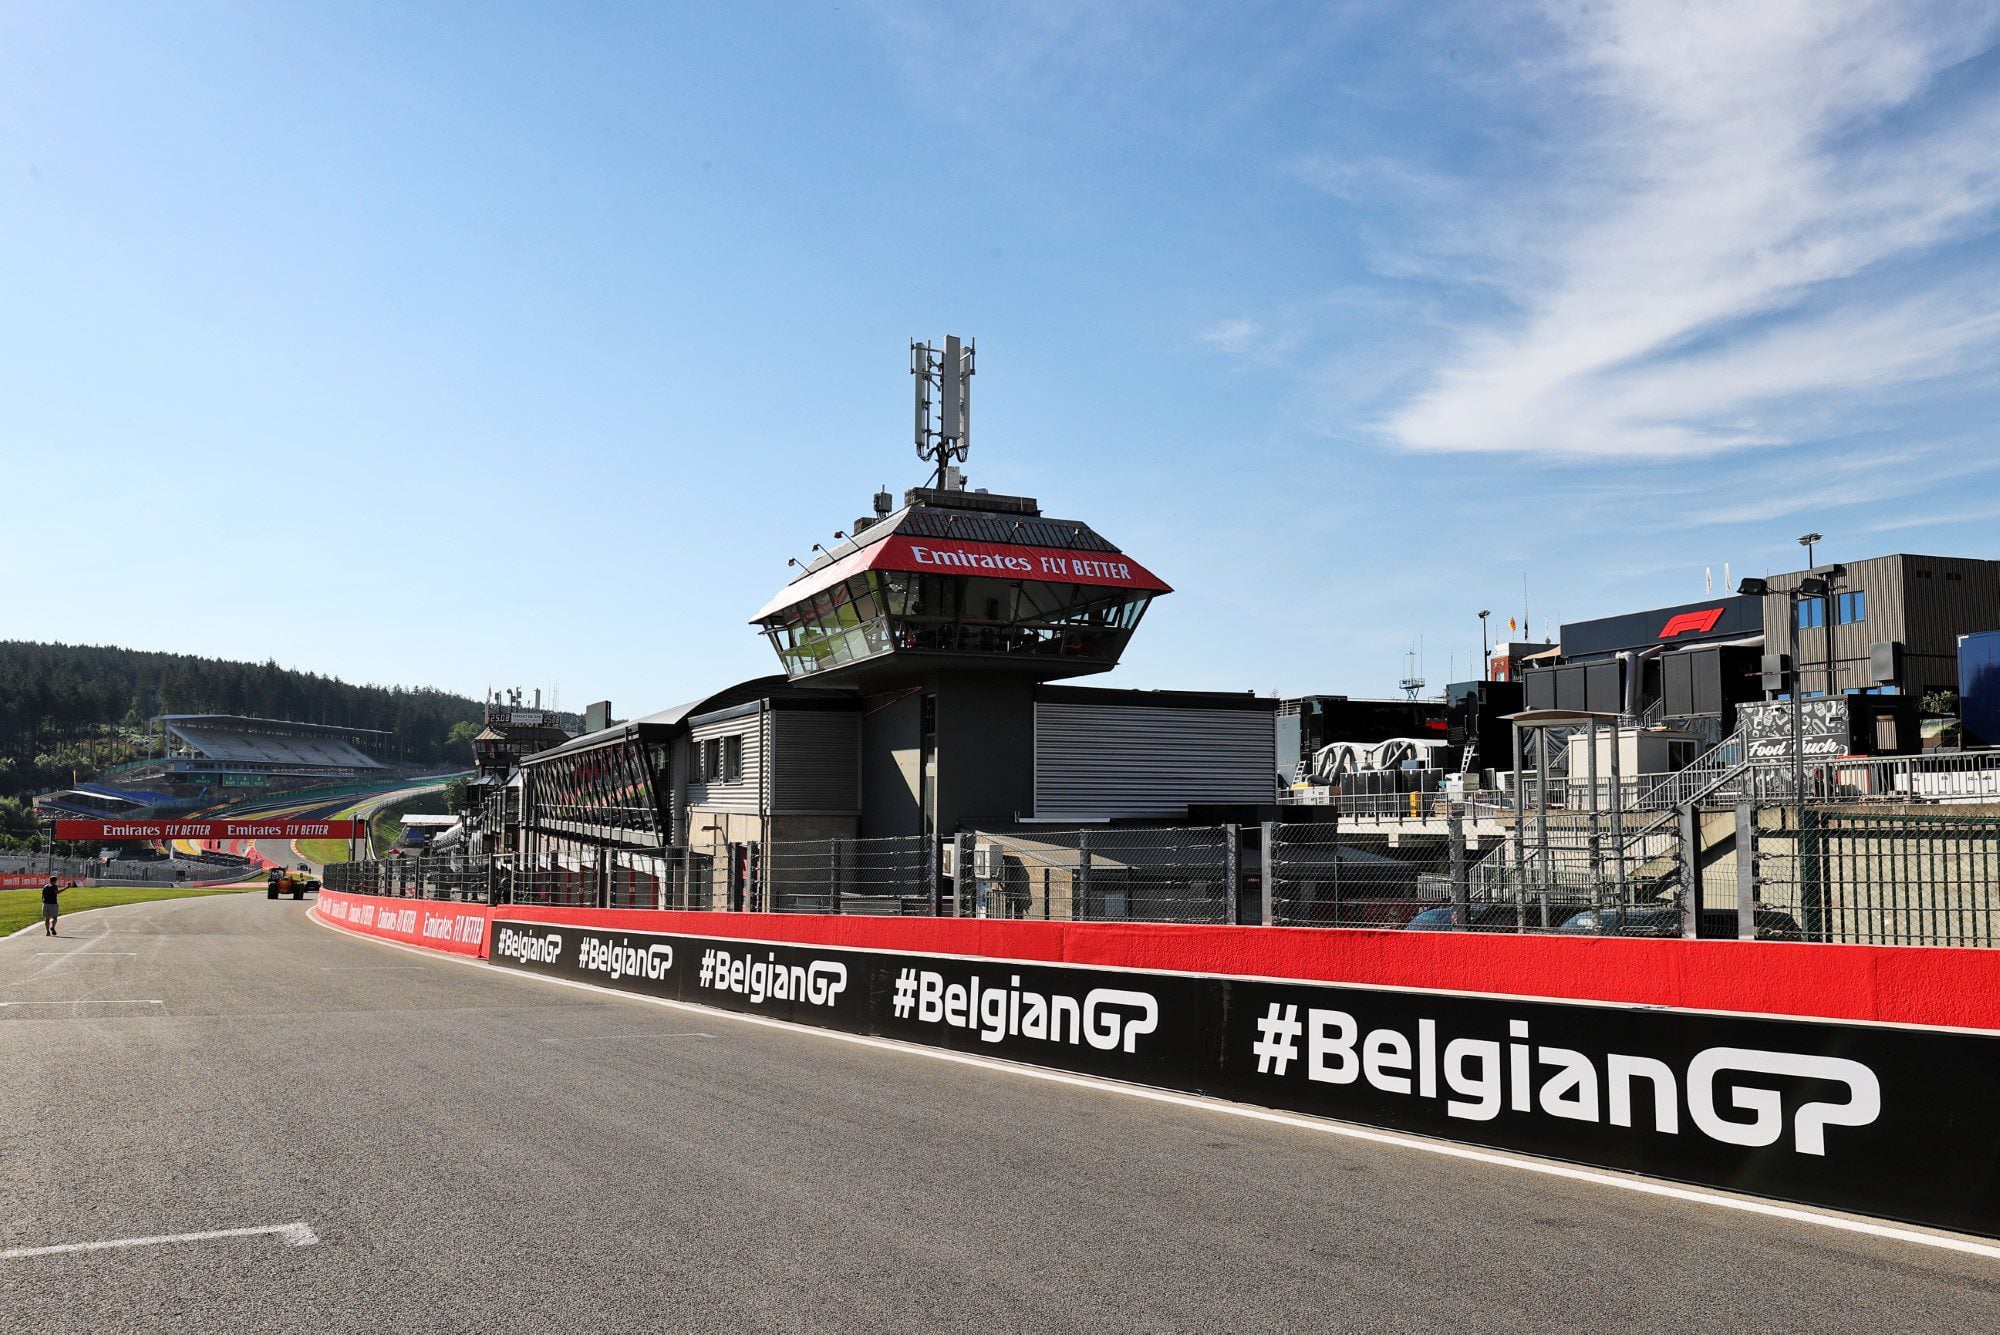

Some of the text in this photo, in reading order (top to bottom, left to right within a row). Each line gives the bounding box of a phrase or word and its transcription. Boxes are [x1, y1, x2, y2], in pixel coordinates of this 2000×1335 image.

[911, 545, 1131, 580] Emirates FLY BETTER
[1748, 740, 1788, 757] Food
[103, 824, 211, 836] Emirates FLY BETTER
[227, 824, 329, 836] Emirates FLY BETTER
[423, 912, 453, 940] Emirates
[462, 916, 485, 945] BETTER
[498, 927, 563, 964] #BelgianGP
[578, 936, 673, 980] #BelgianGP
[699, 948, 848, 1007] #BelgianGP
[892, 967, 1159, 1054] #BelgianGP
[1253, 1002, 1881, 1157] #BelgianGP
